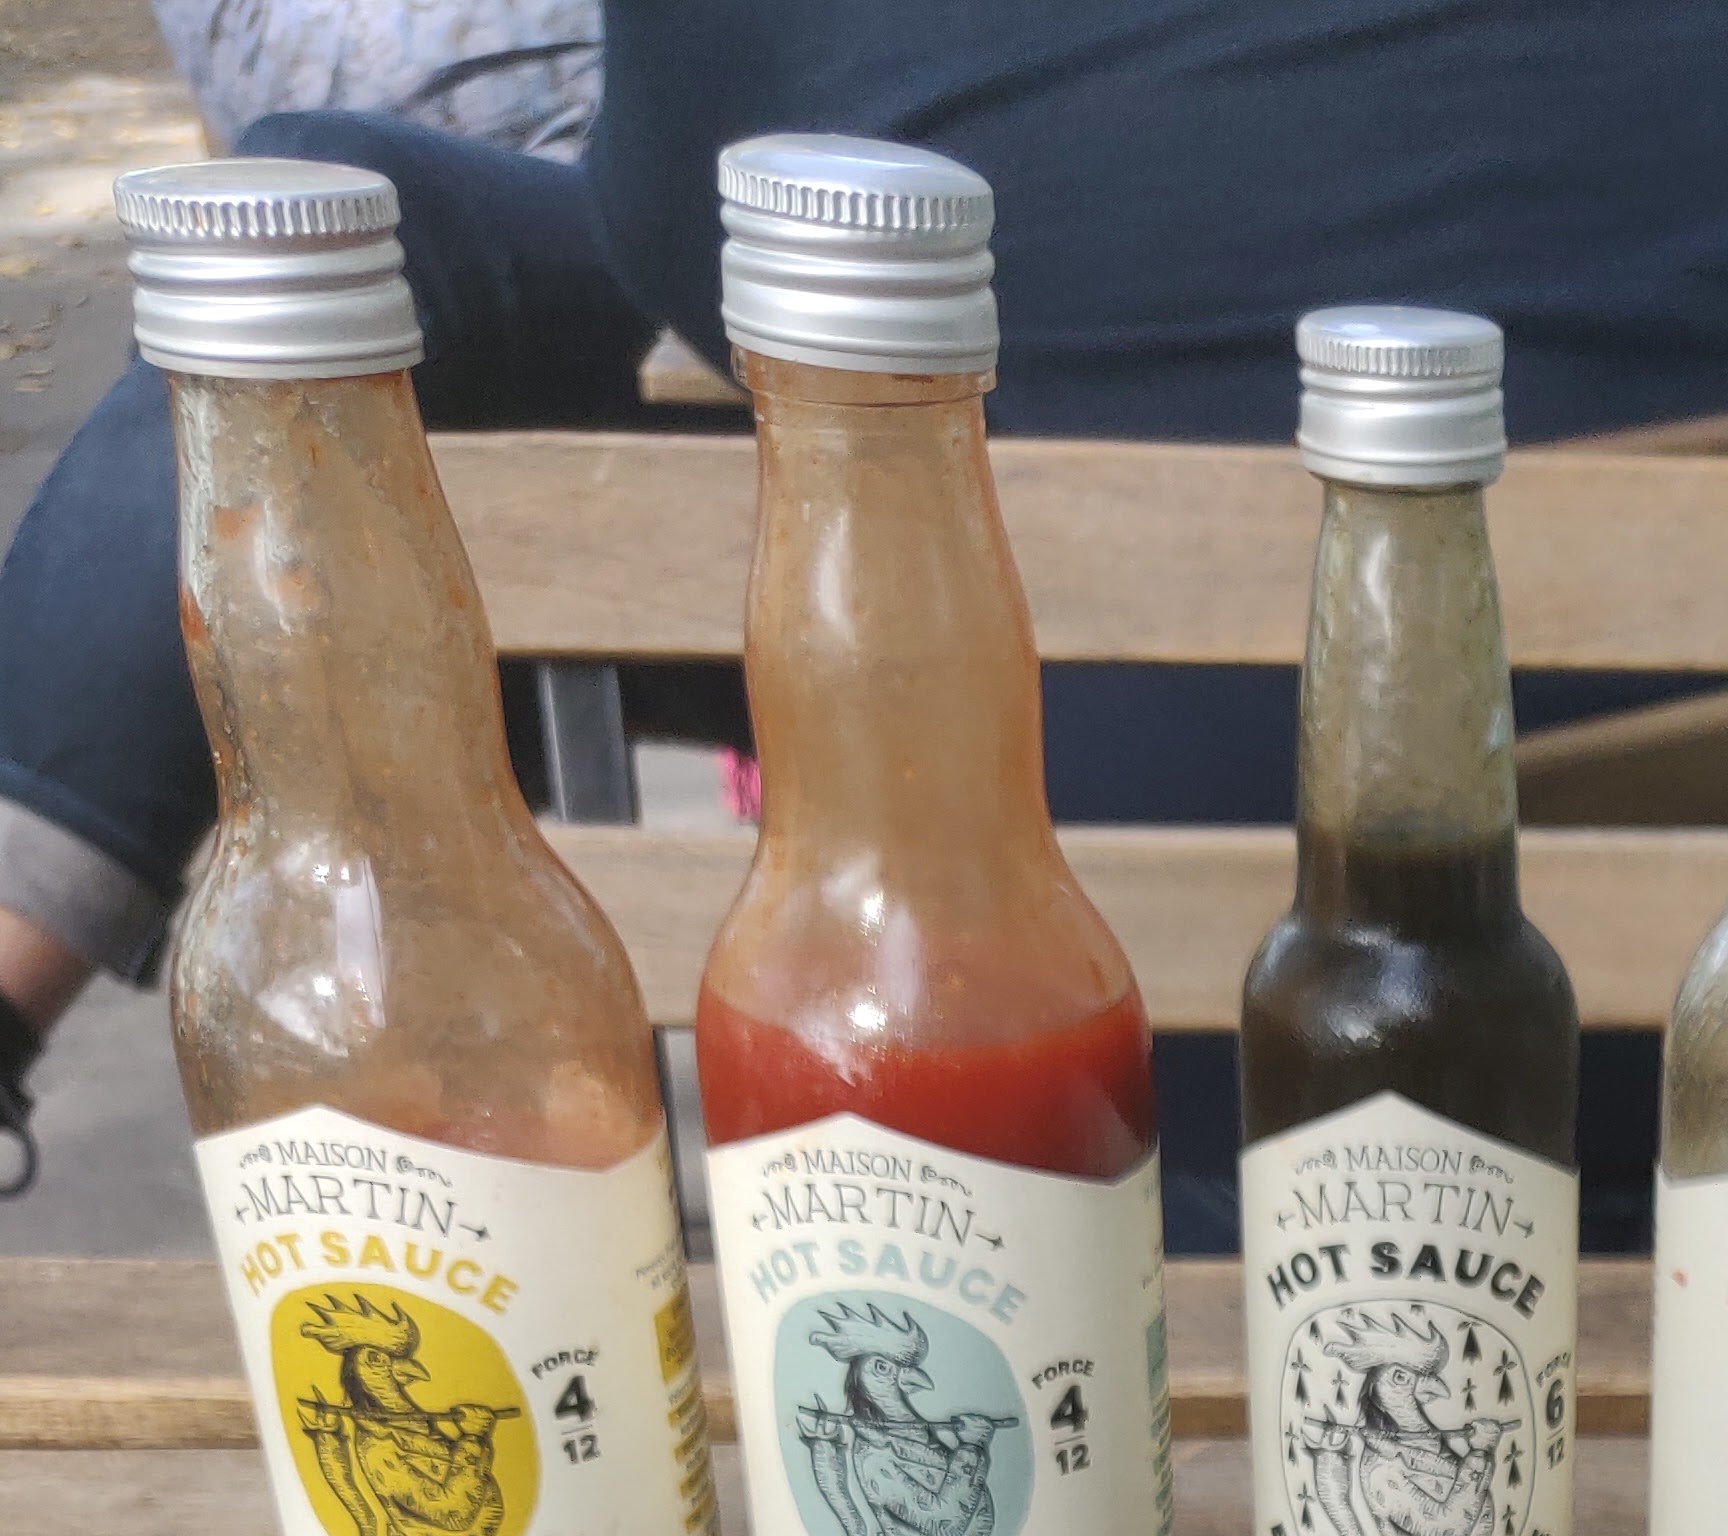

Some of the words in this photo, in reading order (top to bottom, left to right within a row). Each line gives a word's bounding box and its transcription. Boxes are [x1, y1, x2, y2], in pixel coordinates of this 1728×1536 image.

[274, 1140, 388, 1174] MAISON
[801, 1149, 914, 1183] MAISON
[1343, 1145, 1463, 1176] MAISON
[241, 1174, 460, 1239] MARTIN
[761, 1182, 977, 1247] MARTIN
[1292, 1180, 1516, 1239] MARTIN
[240, 1232, 305, 1297] HOT
[322, 1230, 521, 1316] SAUCE
[749, 1240, 821, 1304] HOT
[837, 1239, 1028, 1327] SAUCE
[1266, 1243, 1351, 1312] HOT
[1369, 1241, 1546, 1322] SAUCE
[554, 1373, 597, 1425] 4
[1032, 1358, 1095, 1390] FORCE
[1049, 1383, 1090, 1435] 4
[1546, 1378, 1565, 1430] 6
[563, 1433, 602, 1465] 12
[1054, 1443, 1092, 1476] 12
